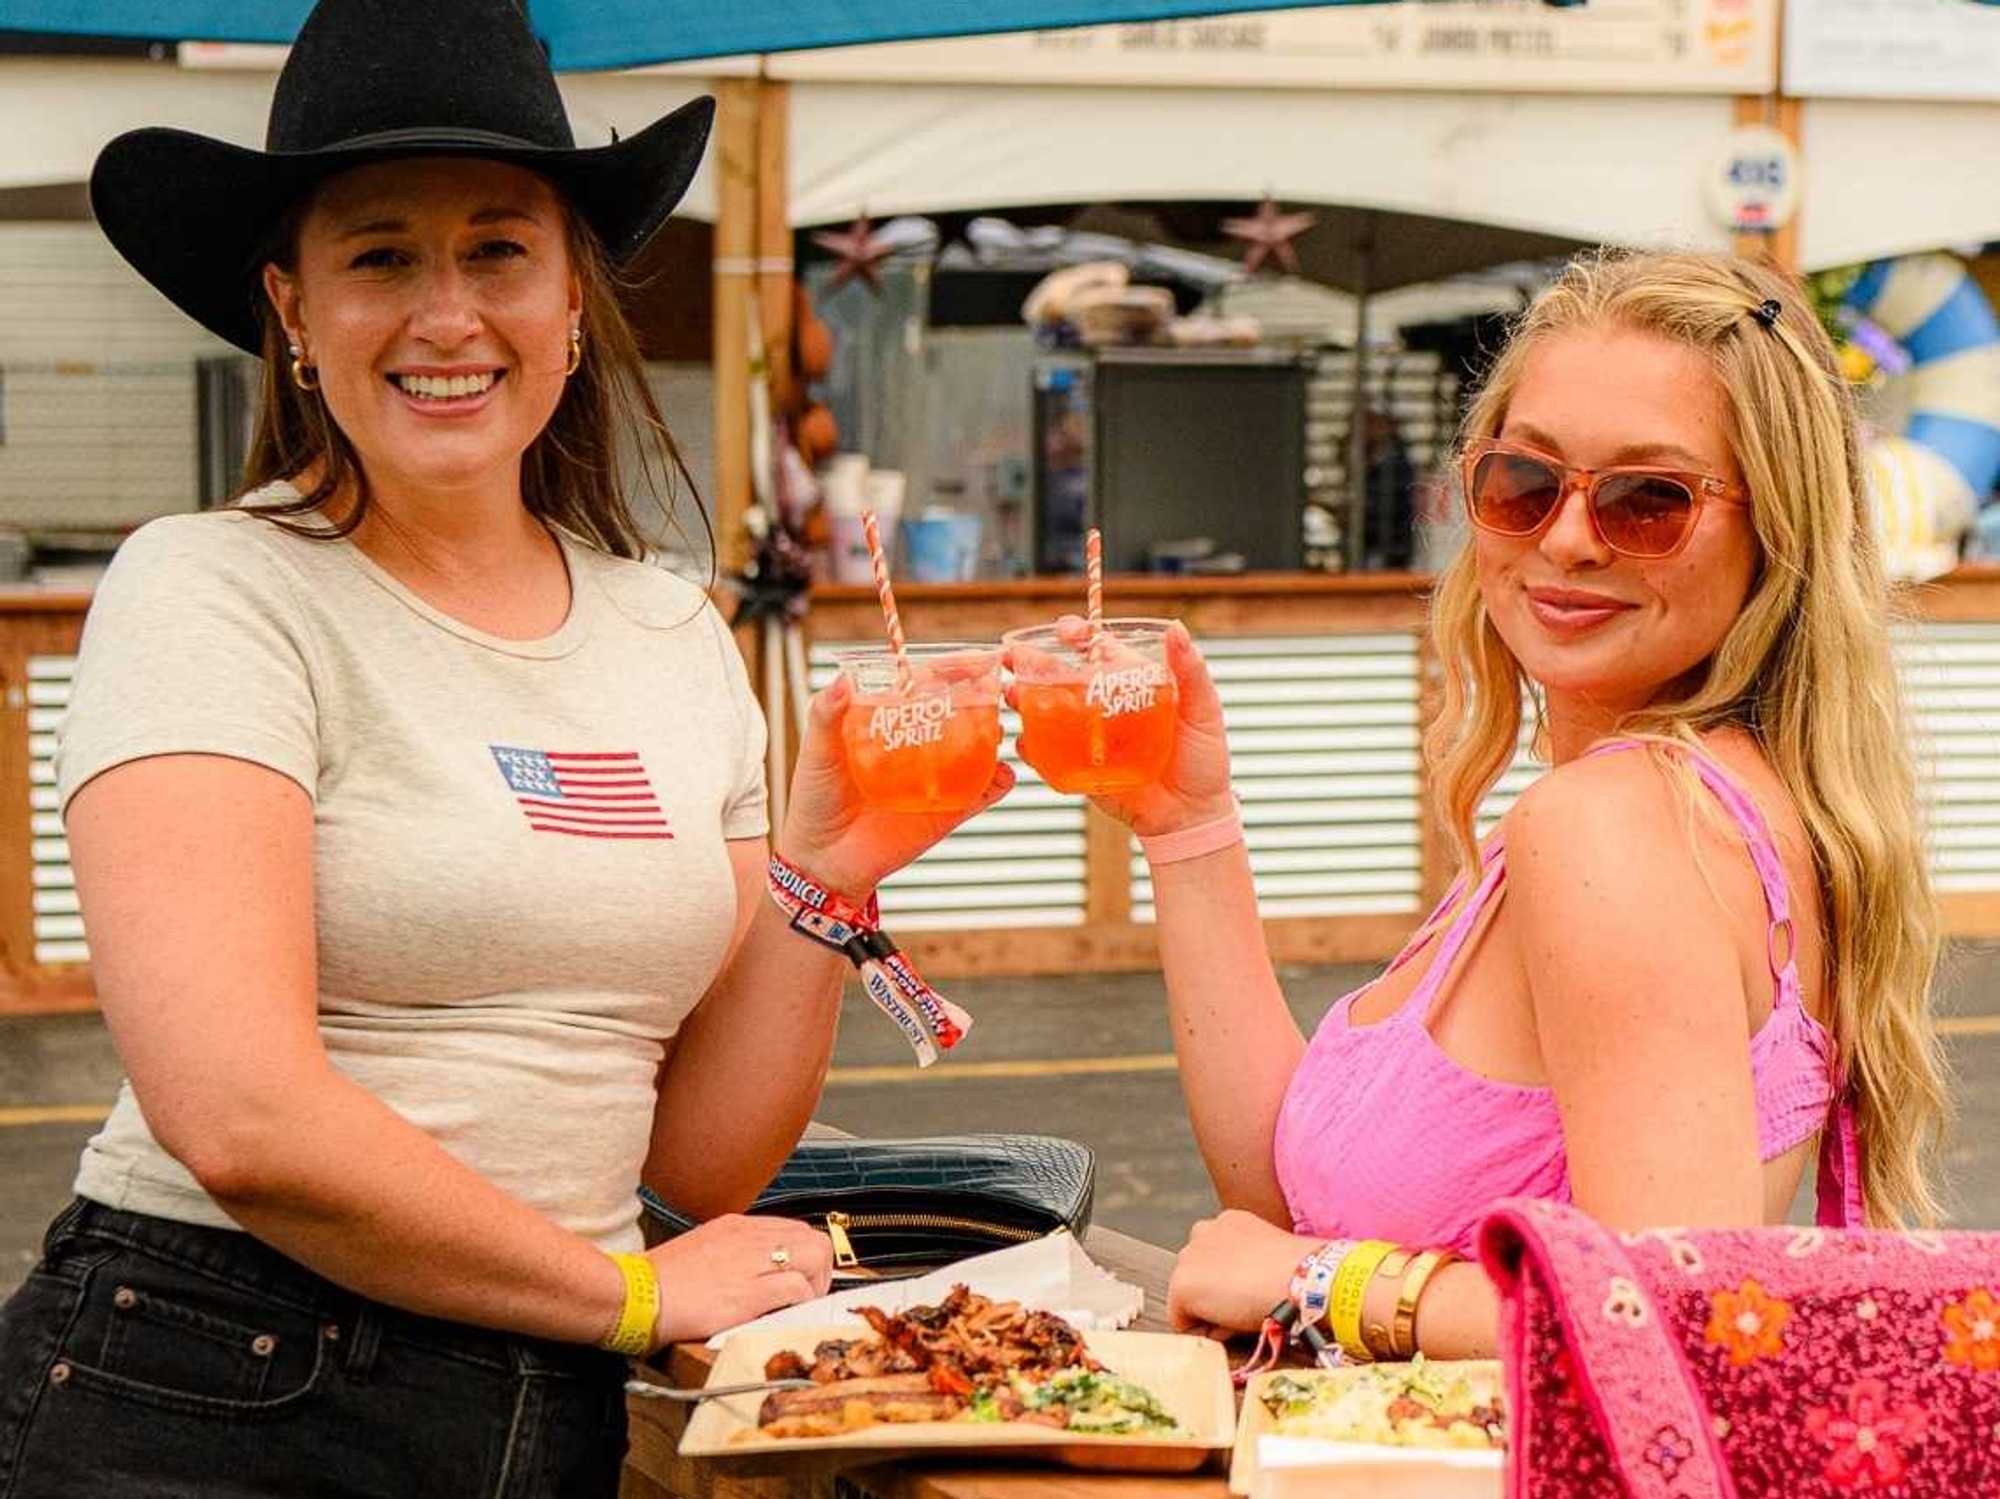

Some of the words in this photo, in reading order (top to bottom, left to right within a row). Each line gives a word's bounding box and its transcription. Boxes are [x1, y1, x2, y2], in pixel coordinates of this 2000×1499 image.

[868, 695, 957, 739] APEROL
[883, 721, 943, 752] SPRITZ
[870, 973, 924, 1044] WINTRUST
